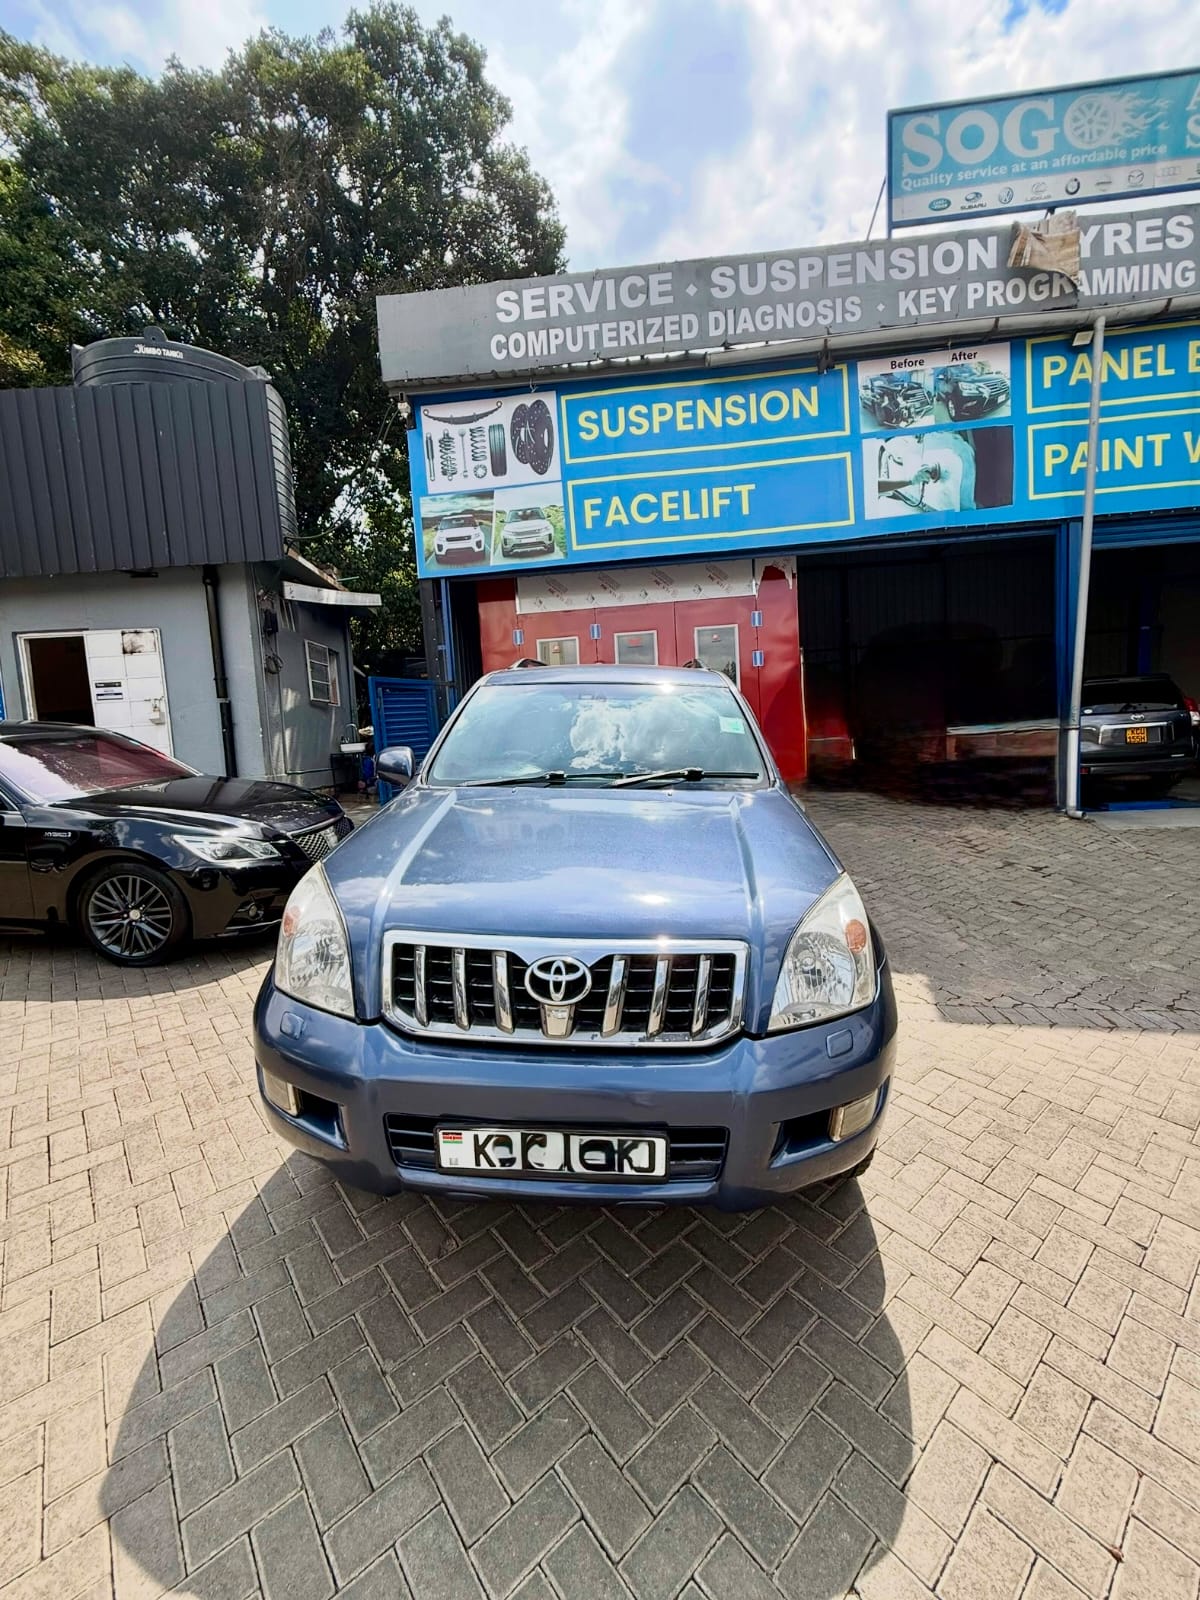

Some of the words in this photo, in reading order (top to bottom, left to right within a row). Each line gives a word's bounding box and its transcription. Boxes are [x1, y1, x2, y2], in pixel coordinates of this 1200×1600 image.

[902, 172, 953, 191] Quality
[957, 163, 1007, 180] service
[1011, 160, 1027, 173] at
[1030, 159, 1048, 171] an
[1052, 146, 1128, 168] affordable
[1131, 143, 1168, 160] price
[496, 272, 674, 323] SERVICE
[710, 236, 997, 299] SUSPENSION
[1080, 215, 1194, 259] YRES
[490, 312, 699, 360] COMPUTERIZED
[708, 296, 862, 337] DIAGNOSIS
[898, 284, 958, 318] KEY
[890, 358, 925, 370] Before
[951, 351, 978, 362] After
[1043, 343, 1176, 389] PANEL
[578, 386, 819, 441] SUSPENSION
[1044, 433, 1171, 477] PAINT
[583, 483, 756, 529] FACELIFT
